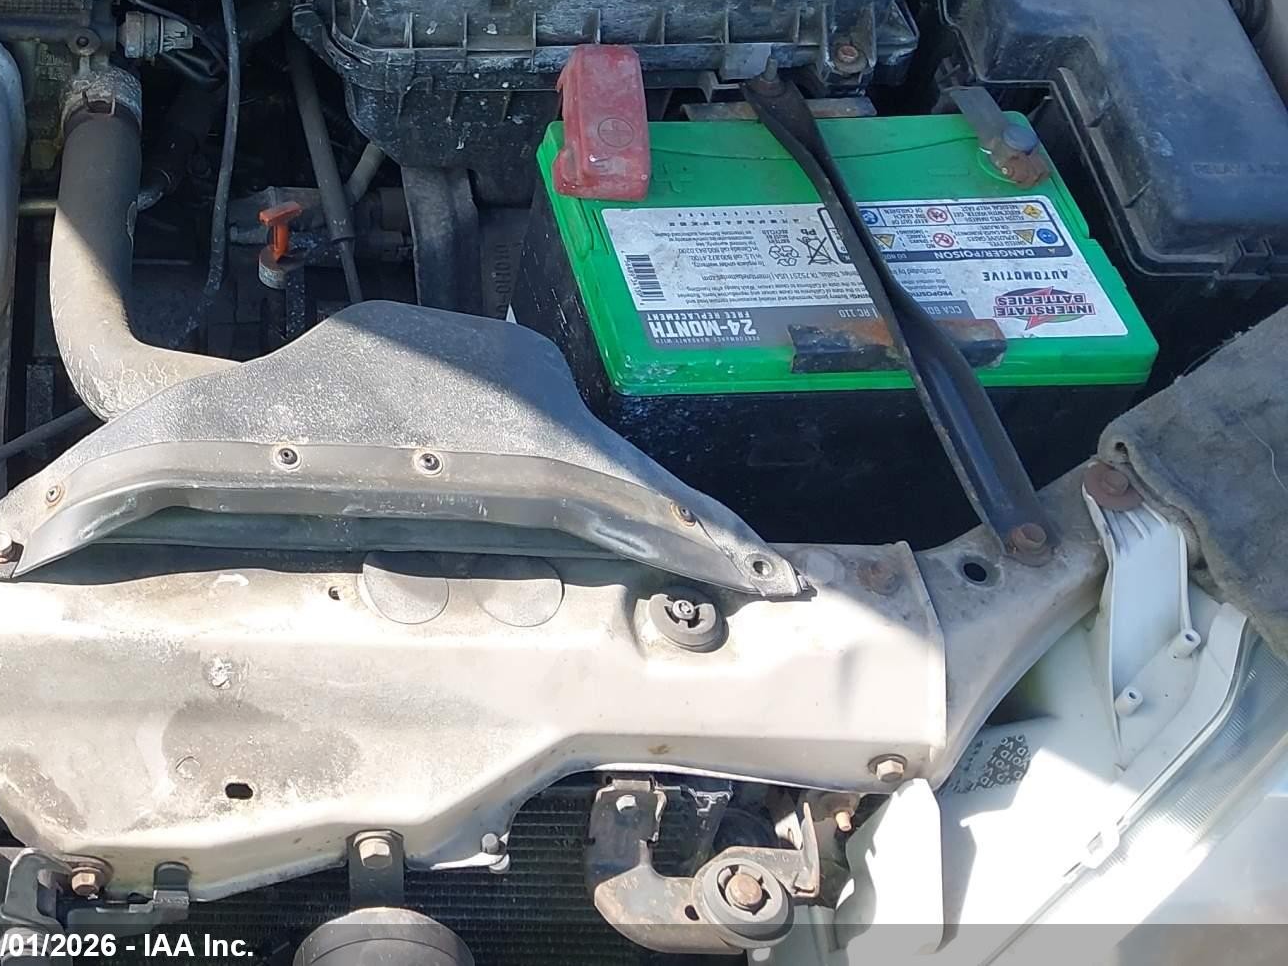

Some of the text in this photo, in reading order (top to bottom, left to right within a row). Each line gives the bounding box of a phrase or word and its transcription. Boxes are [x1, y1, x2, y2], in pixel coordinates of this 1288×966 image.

[932, 248, 1035, 258] DANGER/POISON
[982, 270, 1068, 281] AUTOMOTIVE
[997, 294, 1085, 305] BATTERIES
[645, 310, 750, 320] FREE REPLACEMENT
[837, 308, 856, 317] 110
[996, 304, 1093, 316] INTERSTATE
[647, 319, 757, 337] 24-MONTH
